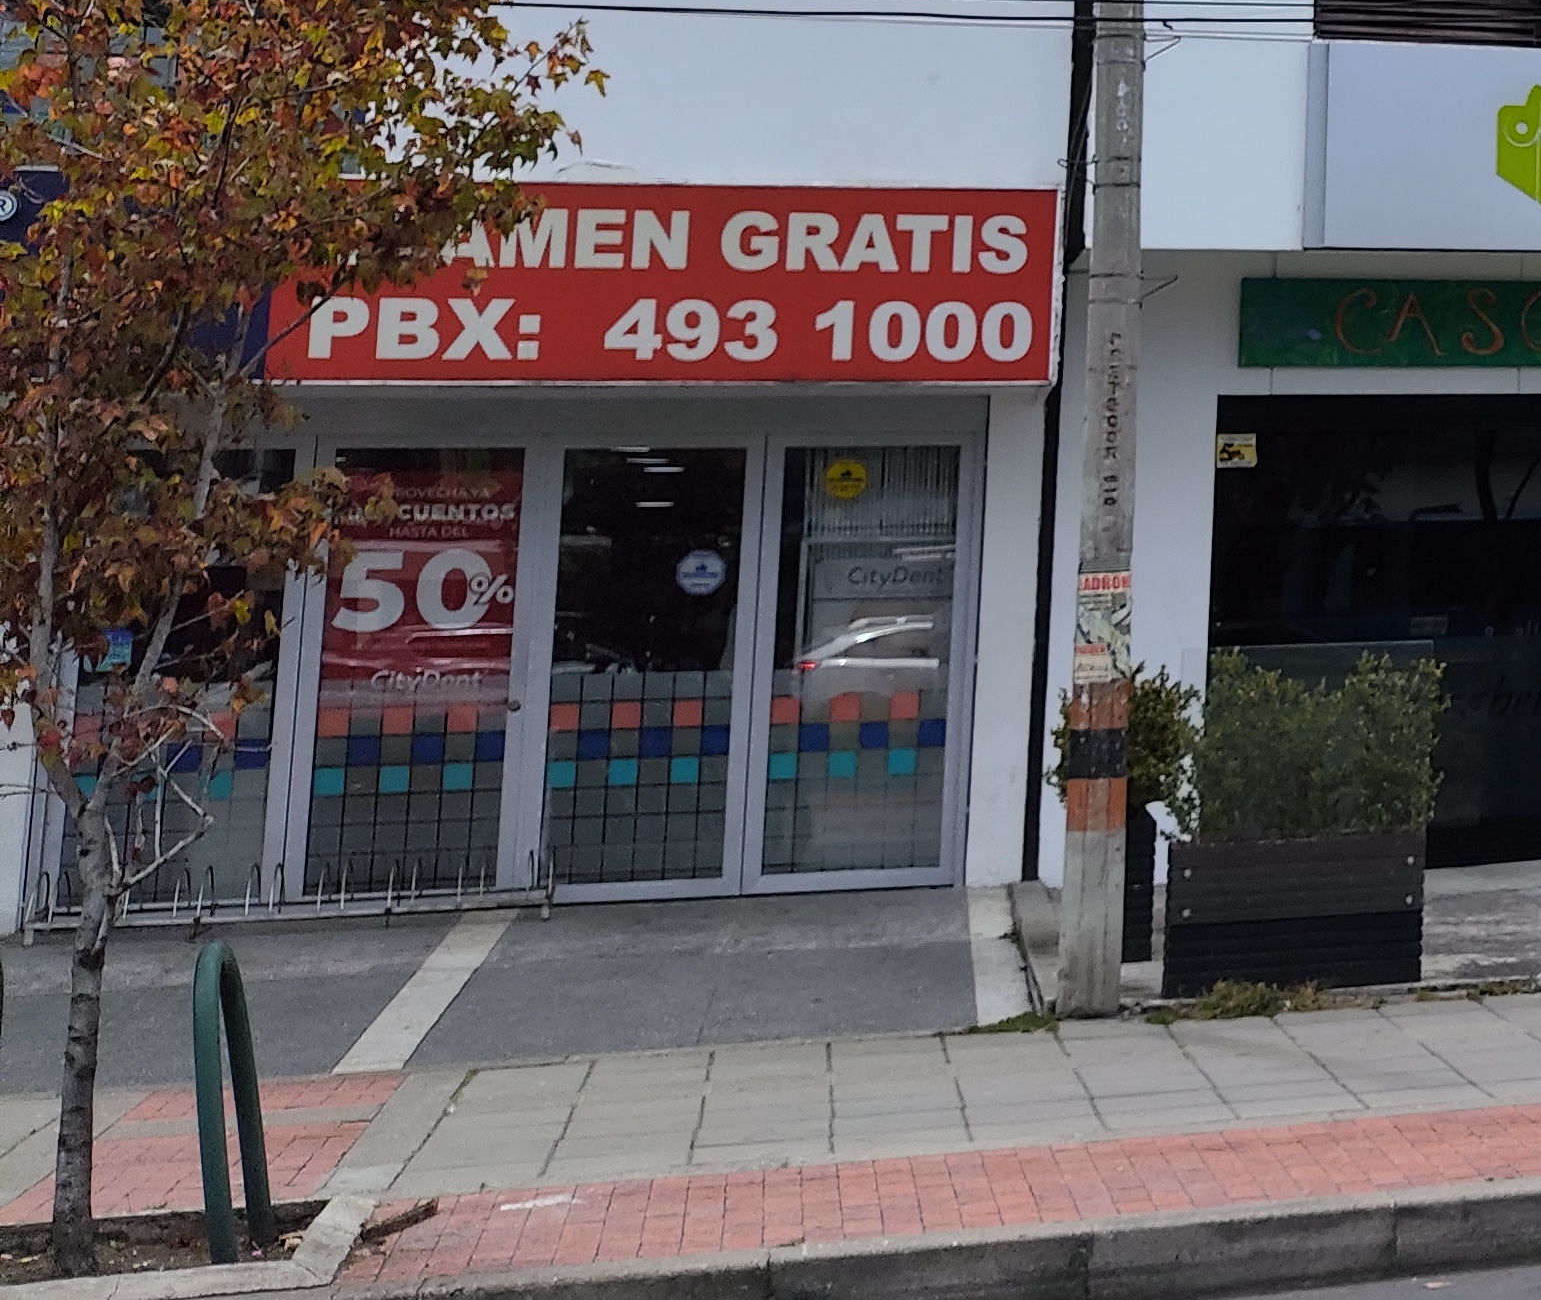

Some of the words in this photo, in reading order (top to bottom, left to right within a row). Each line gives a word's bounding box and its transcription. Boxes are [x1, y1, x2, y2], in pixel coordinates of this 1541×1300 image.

[438, 207, 690, 271] AMEN
[720, 210, 1029, 275] GRATIS
[306, 296, 542, 361] PBX:
[603, 298, 779, 362] 493
[814, 300, 1034, 363] 1000
[846, 565, 944, 588] CityDent
